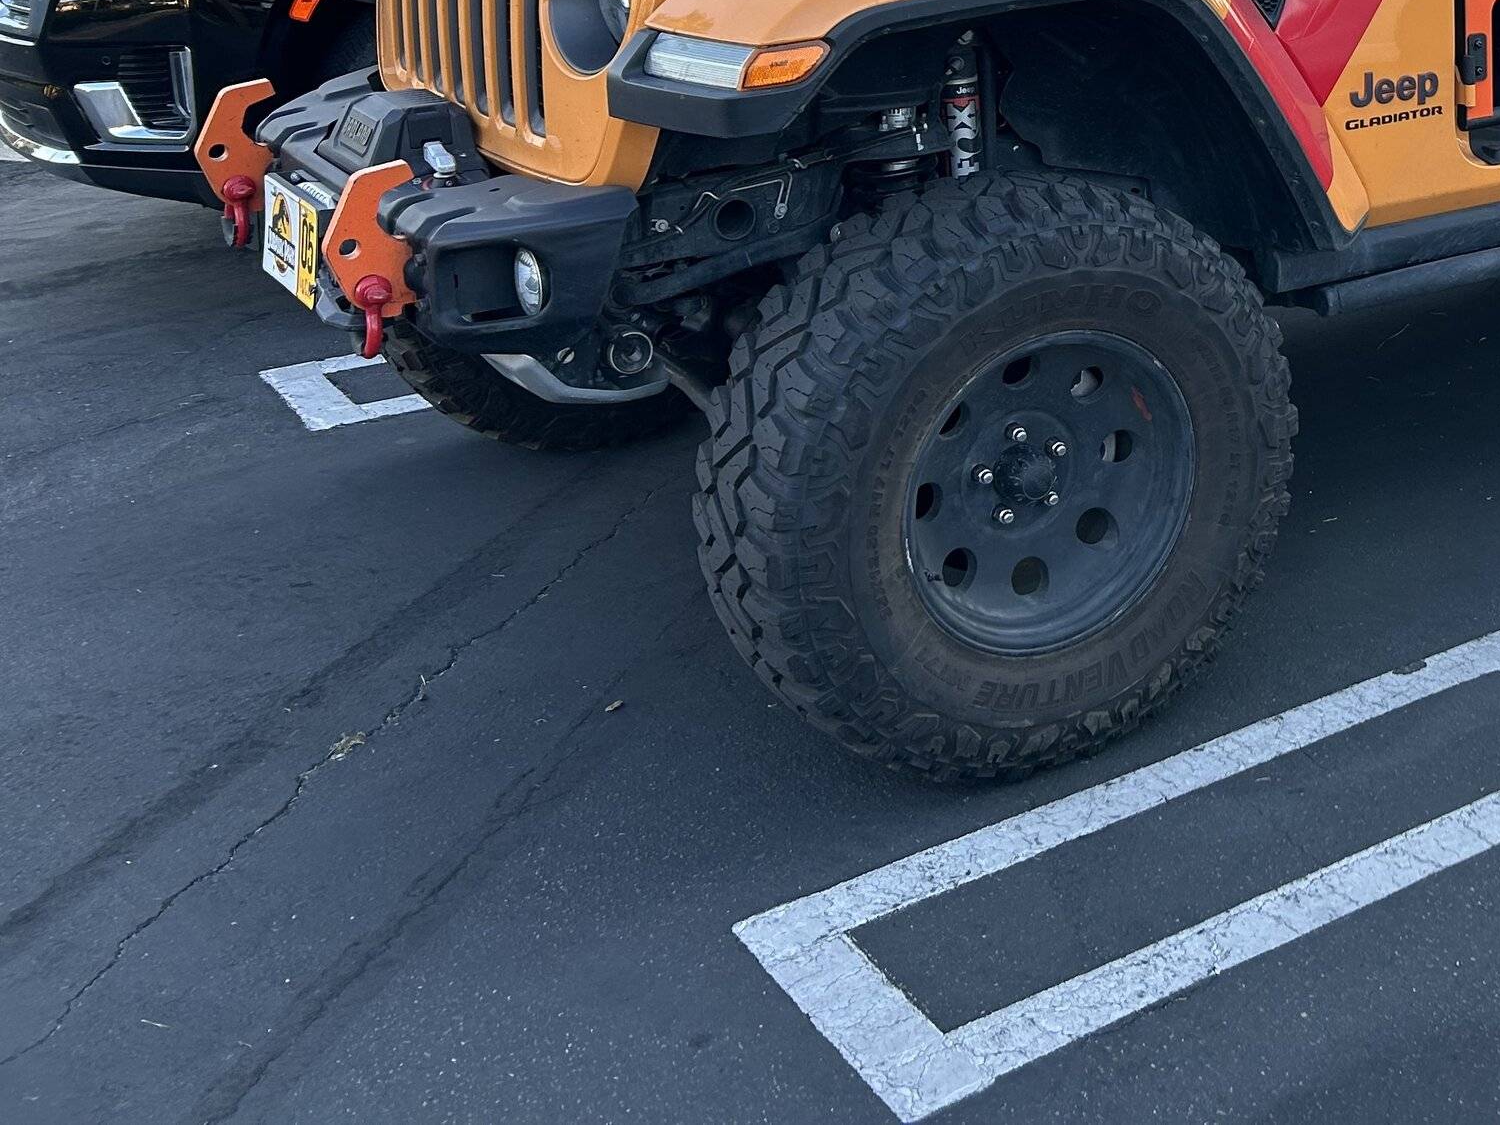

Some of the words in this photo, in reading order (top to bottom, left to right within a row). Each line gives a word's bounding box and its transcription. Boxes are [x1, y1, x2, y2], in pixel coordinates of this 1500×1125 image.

[1348, 70, 1439, 108] Jeep
[1344, 104, 1444, 131] GLADIATOR
[300, 217, 315, 275] 05
[957, 280, 1164, 355] KUMHO
[971, 654, 1129, 710] VENTURE
